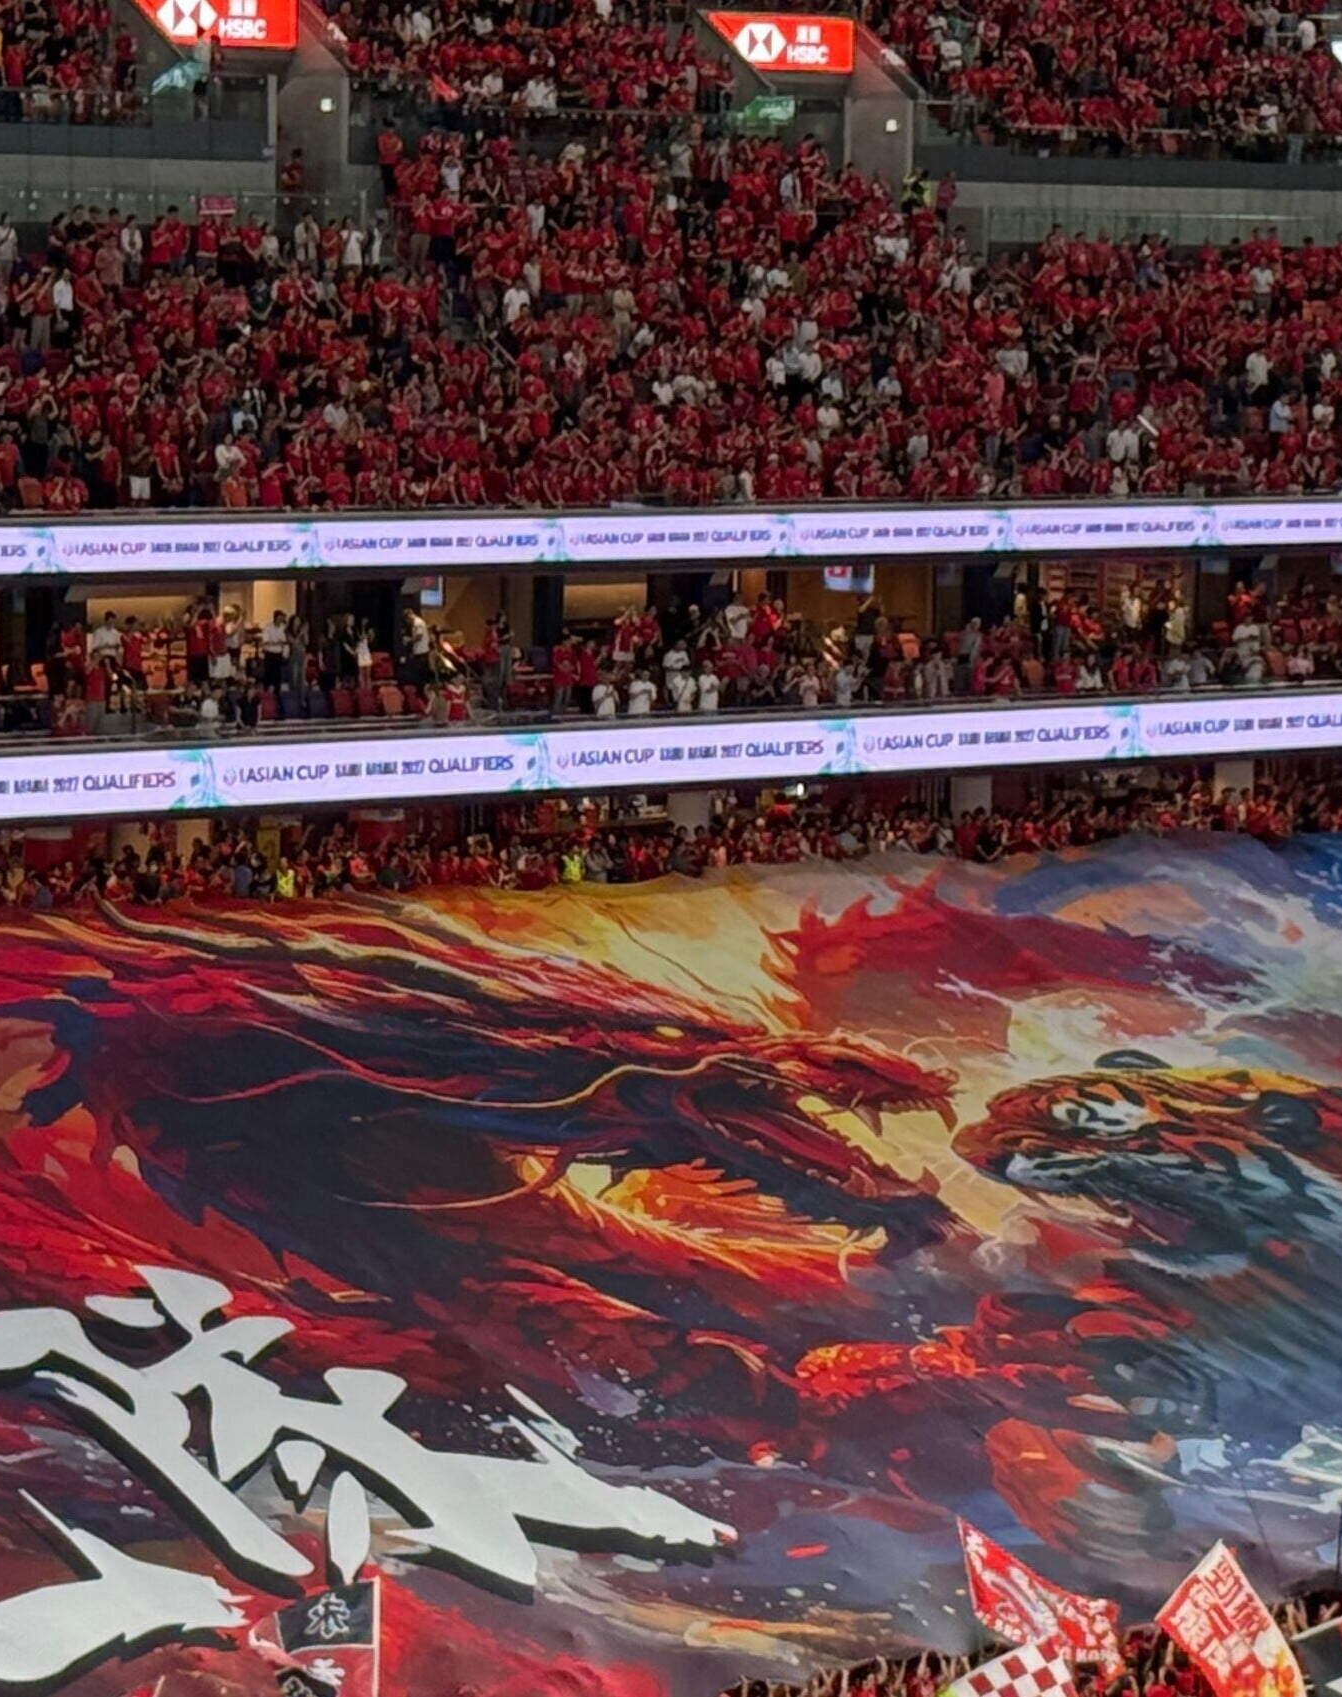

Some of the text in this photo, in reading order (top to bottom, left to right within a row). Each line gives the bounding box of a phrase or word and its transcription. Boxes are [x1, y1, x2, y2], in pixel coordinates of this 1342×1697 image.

[218, 17, 268, 40] HSBC
[787, 44, 829, 64] HSBC
[880, 734, 924, 751] ASIAN
[924, 732, 954, 749] CUP
[1036, 724, 1110, 743] QUALIFIERS
[576, 749, 622, 767] ASIAN
[623, 747, 655, 765] CUP
[744, 739, 824, 758] QUALIFIERS
[245, 765, 294, 784] ASIAN
[295, 763, 330, 781] CUP
[427, 754, 515, 774] QUALIFIERS
[51, 775, 80, 794] 2027
[81, 770, 177, 792] QUALIFIERS
